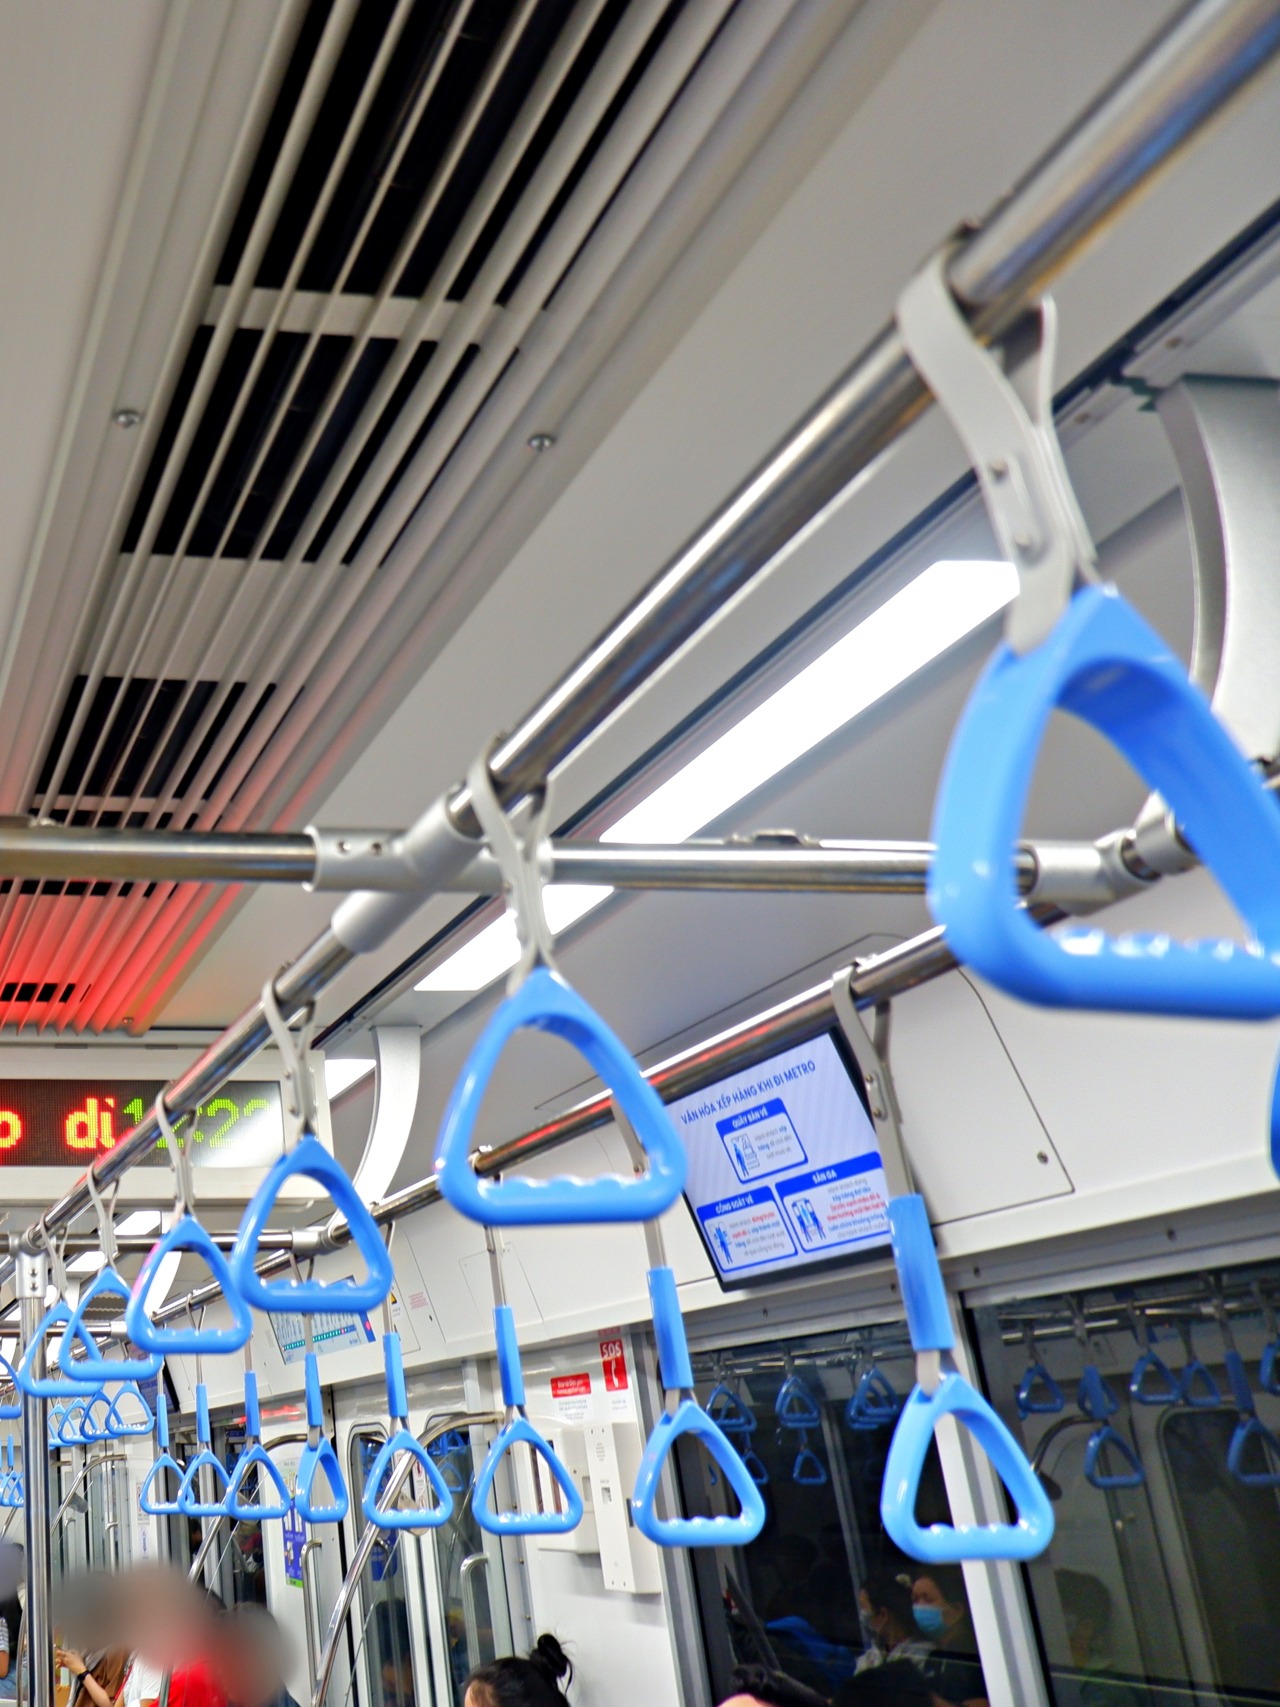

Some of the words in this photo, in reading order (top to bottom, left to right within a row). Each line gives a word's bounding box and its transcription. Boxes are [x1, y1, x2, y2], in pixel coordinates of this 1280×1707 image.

[681, 1108, 699, 1125] VĂN
[699, 1102, 717, 1119] HÓA
[716, 1094, 732, 1112] XẾP
[732, 1084, 758, 1104] HÀNG
[757, 1078, 774, 1093] KHI
[772, 1073, 785, 1087] ĐI
[783, 1060, 816, 1082] METRO
[602, 1342, 622, 1359] SOS
